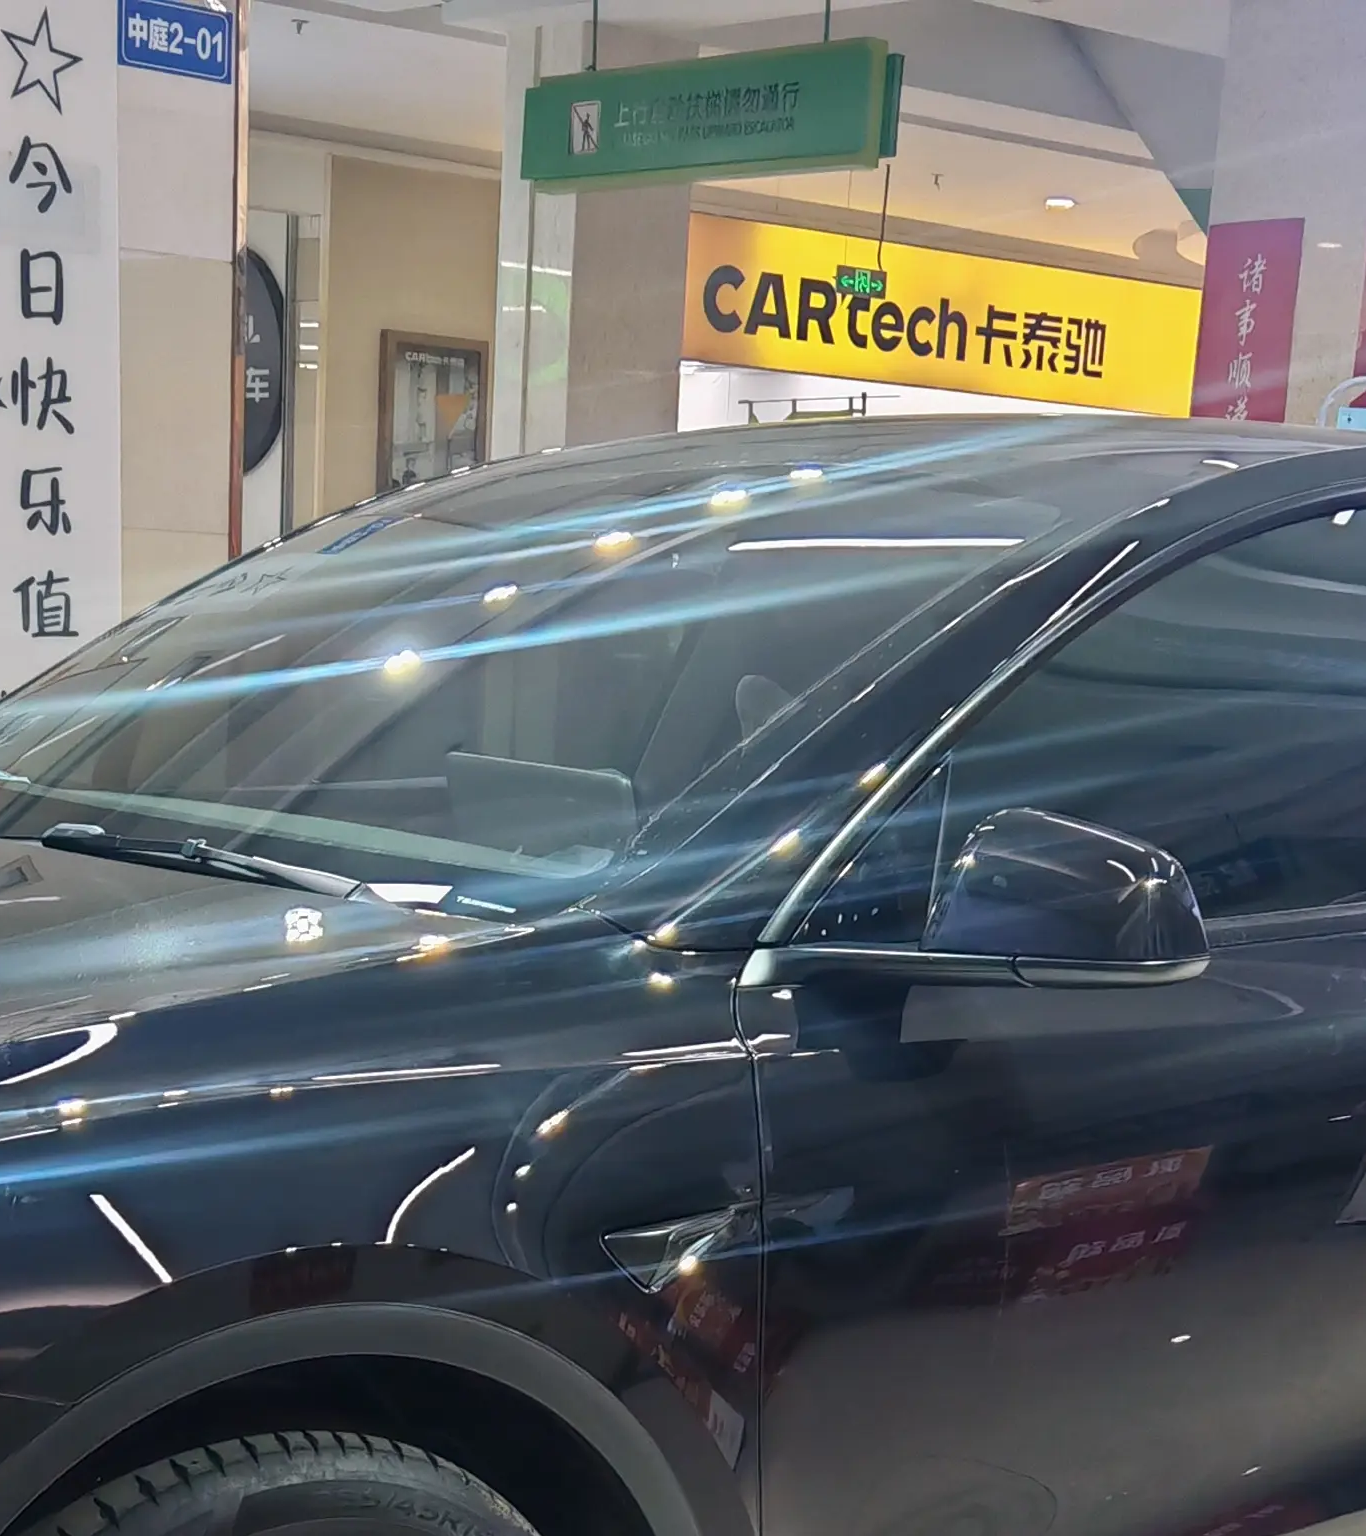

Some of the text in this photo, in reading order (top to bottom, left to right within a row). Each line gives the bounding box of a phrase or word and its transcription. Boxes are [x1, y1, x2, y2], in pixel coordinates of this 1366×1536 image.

[127, 15, 227, 62] 中庭2-01
[702, 264, 1108, 380] CARtech 卡泰驰
[8, 136, 79, 639] 今日快乐值
